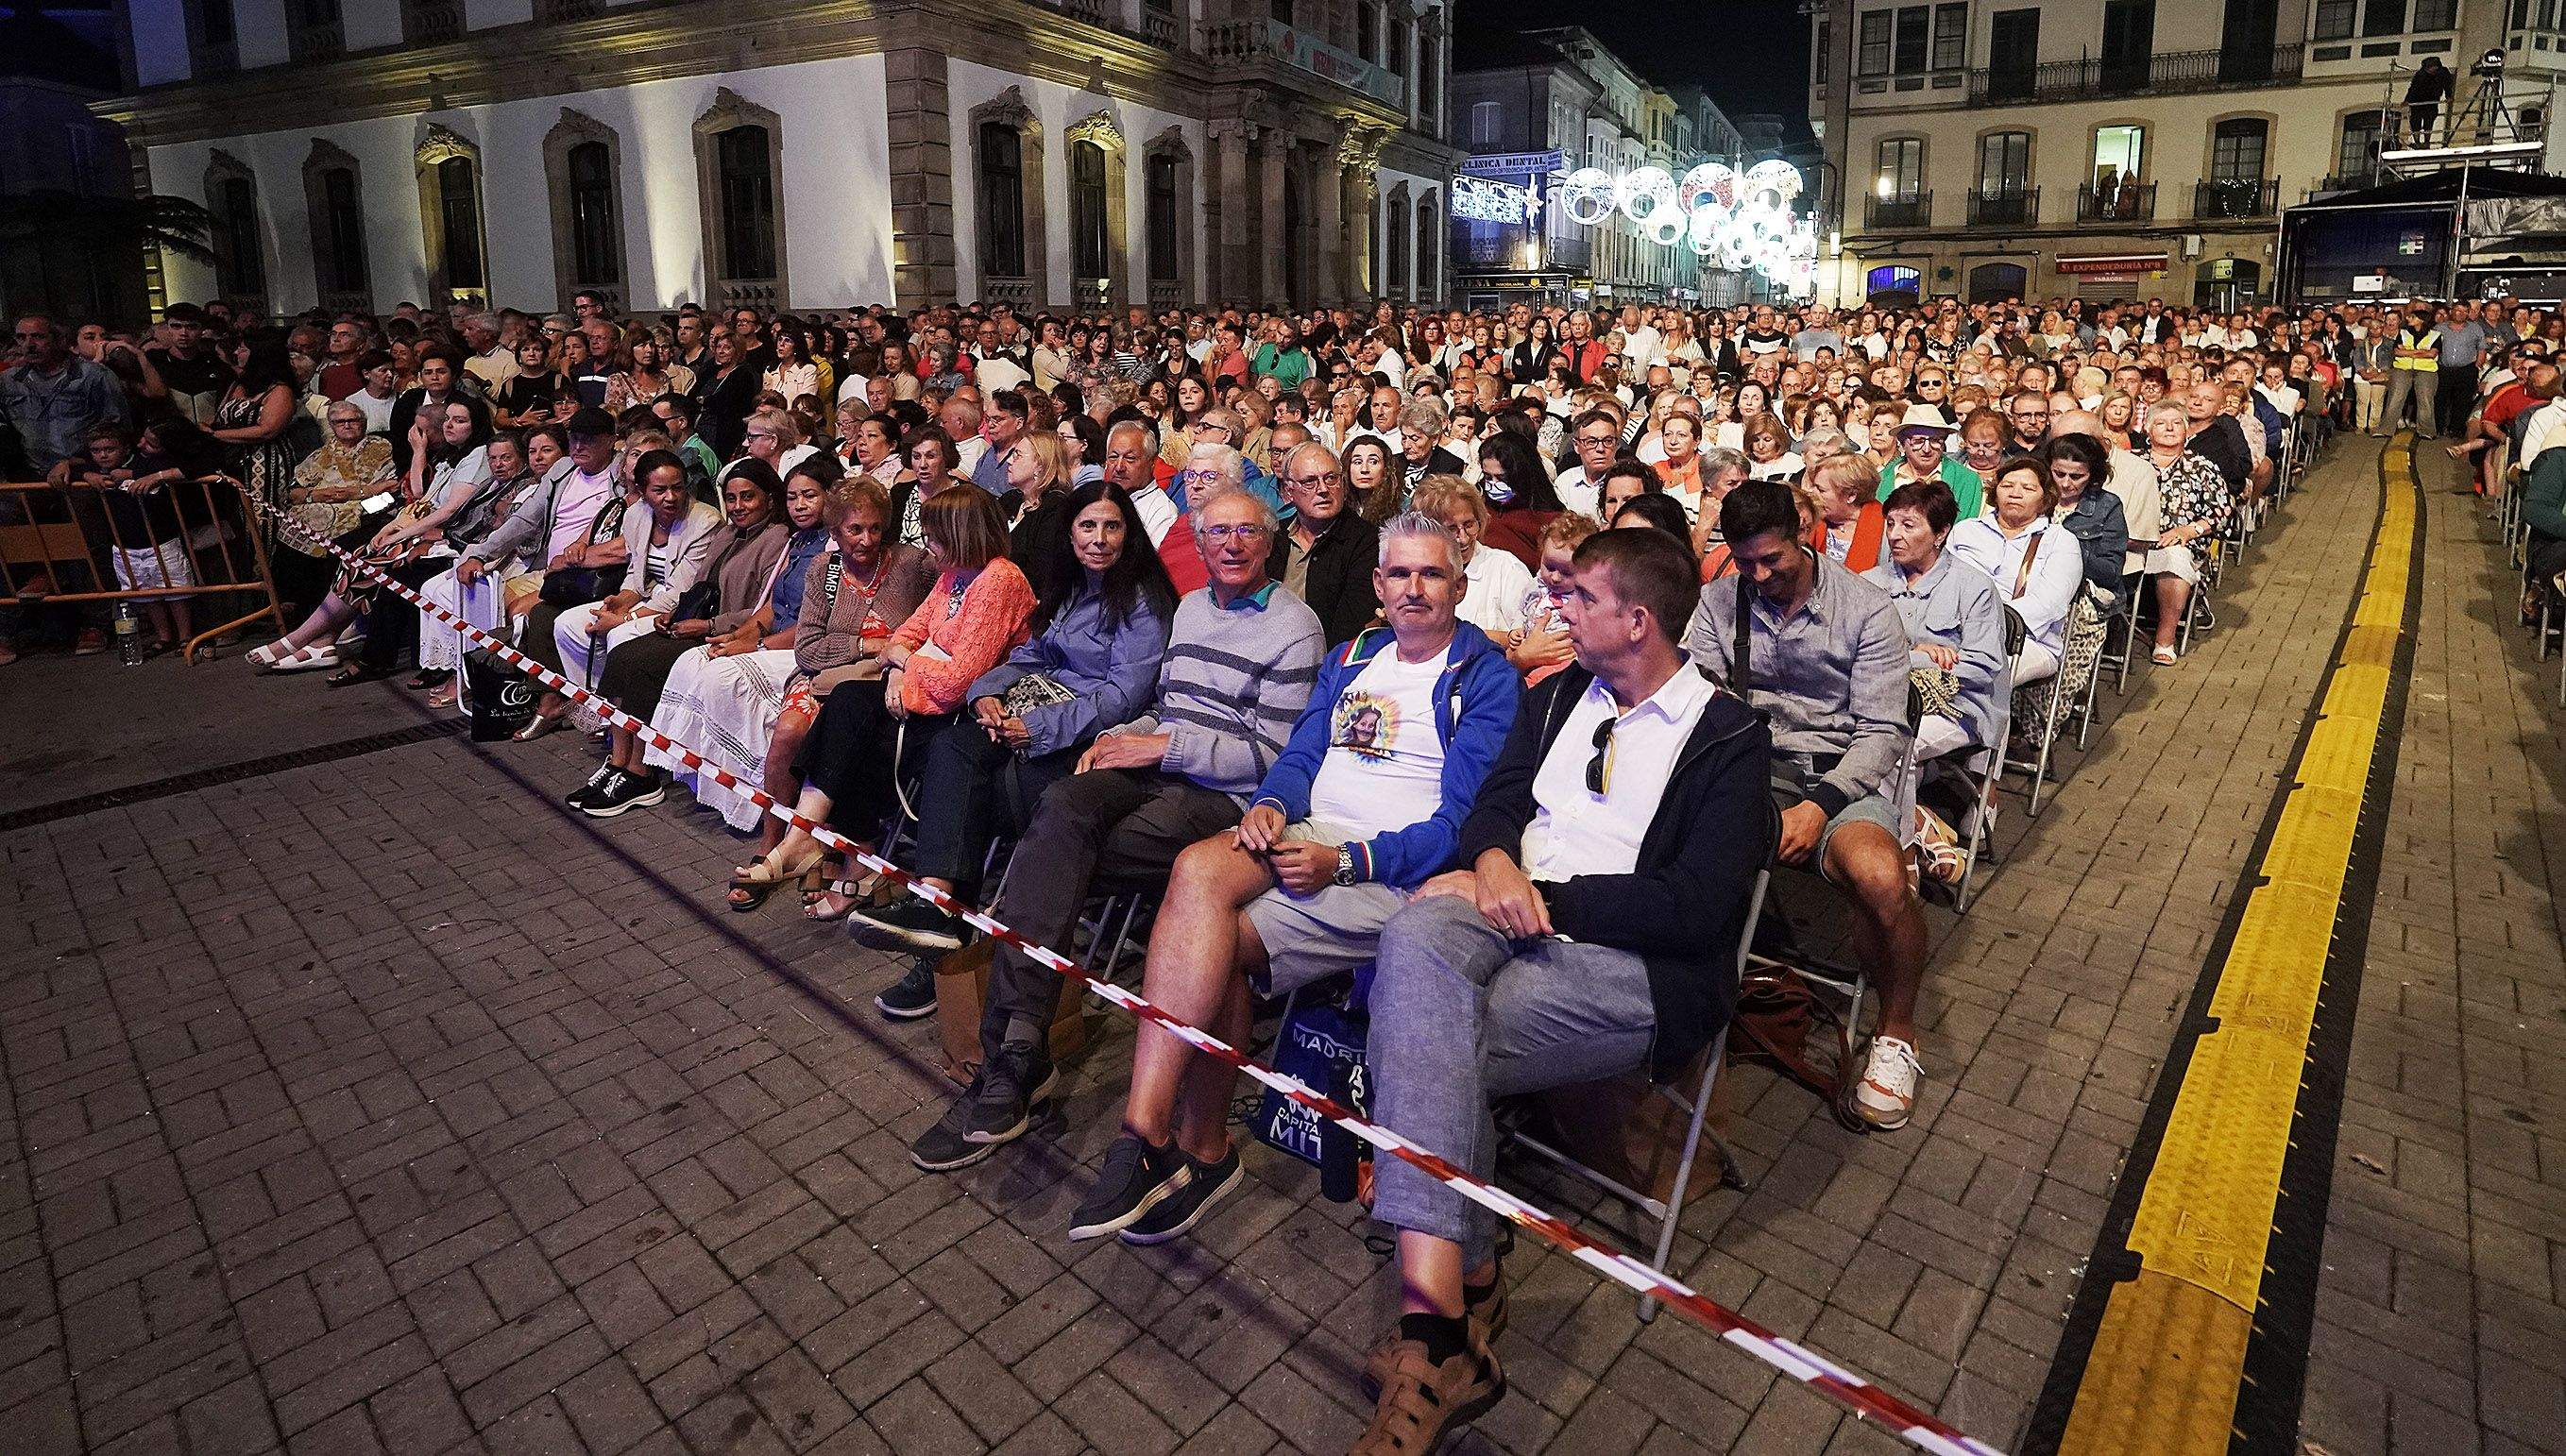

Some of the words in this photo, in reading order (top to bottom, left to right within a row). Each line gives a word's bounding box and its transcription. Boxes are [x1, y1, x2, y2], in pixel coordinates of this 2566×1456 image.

[1505, 156, 1546, 167] DENTAL
[1293, 1028, 1368, 1066] MADRI
[1278, 1107, 1322, 1137] CAPITA
